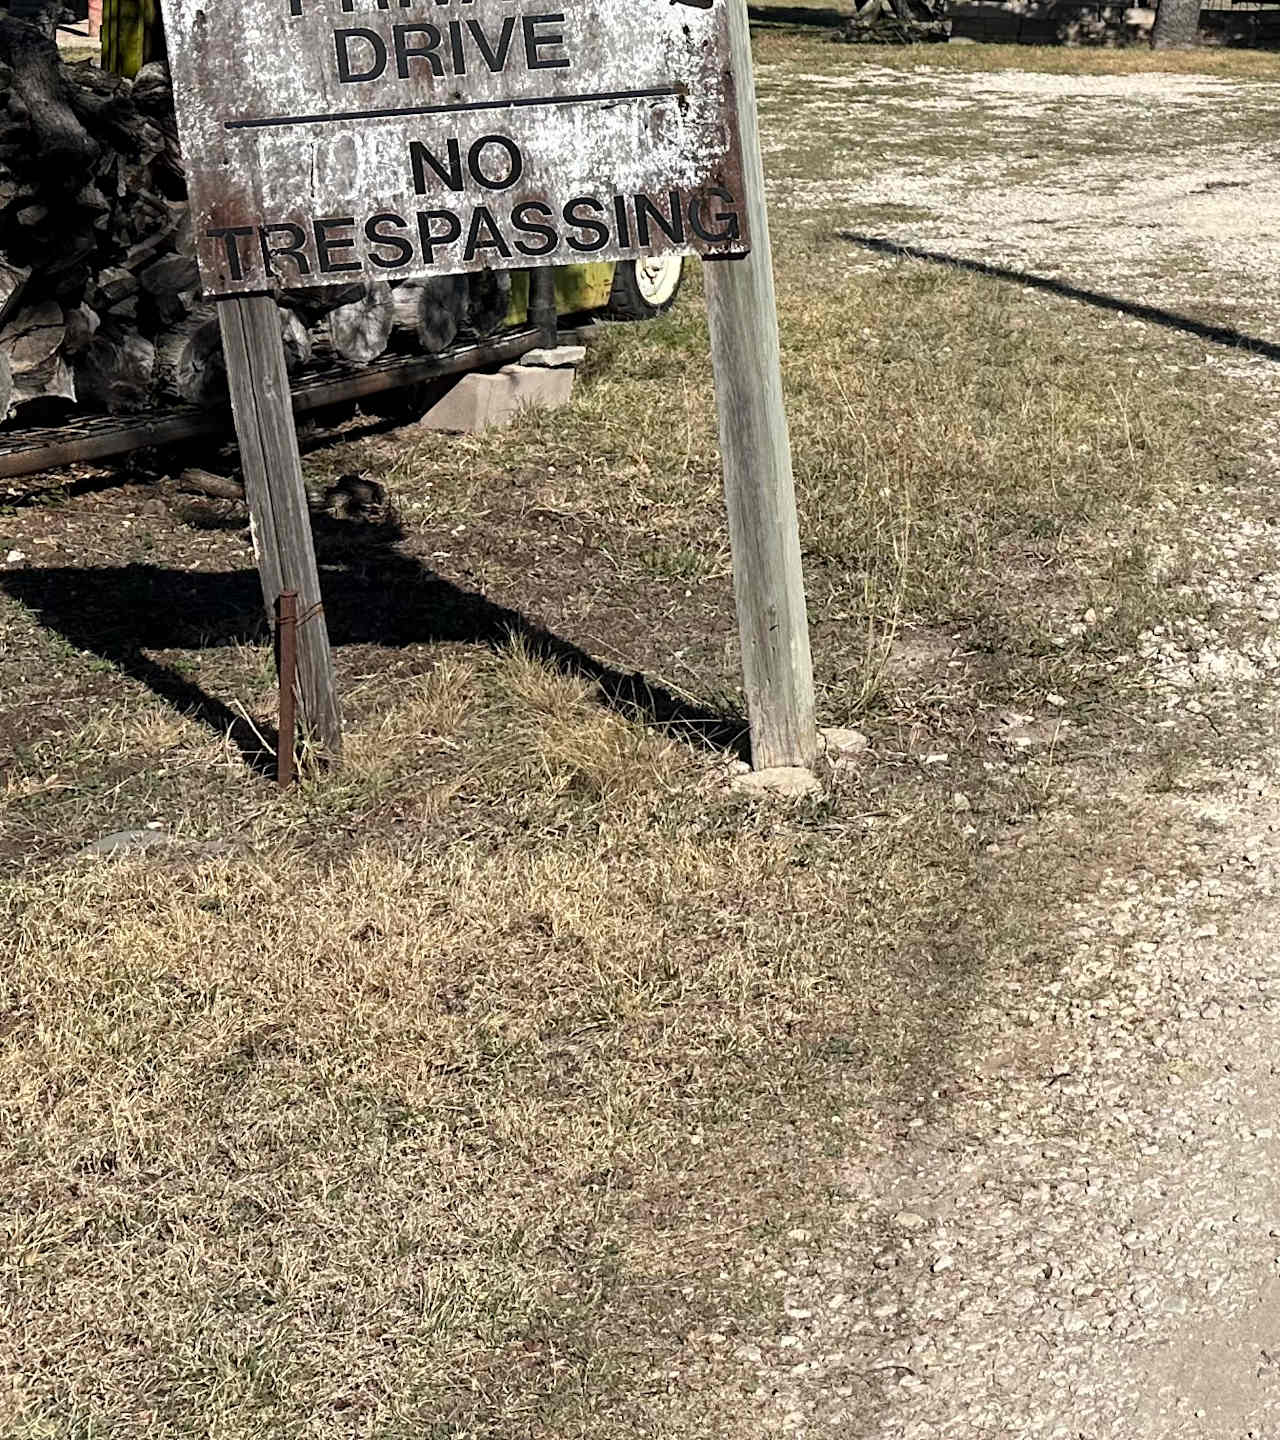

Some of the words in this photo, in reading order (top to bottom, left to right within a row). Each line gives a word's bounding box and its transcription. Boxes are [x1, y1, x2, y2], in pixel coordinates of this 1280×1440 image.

[334, 14, 571, 84] DRIVE
[409, 134, 523, 195] NO
[207, 187, 741, 282] TRESPASSING
